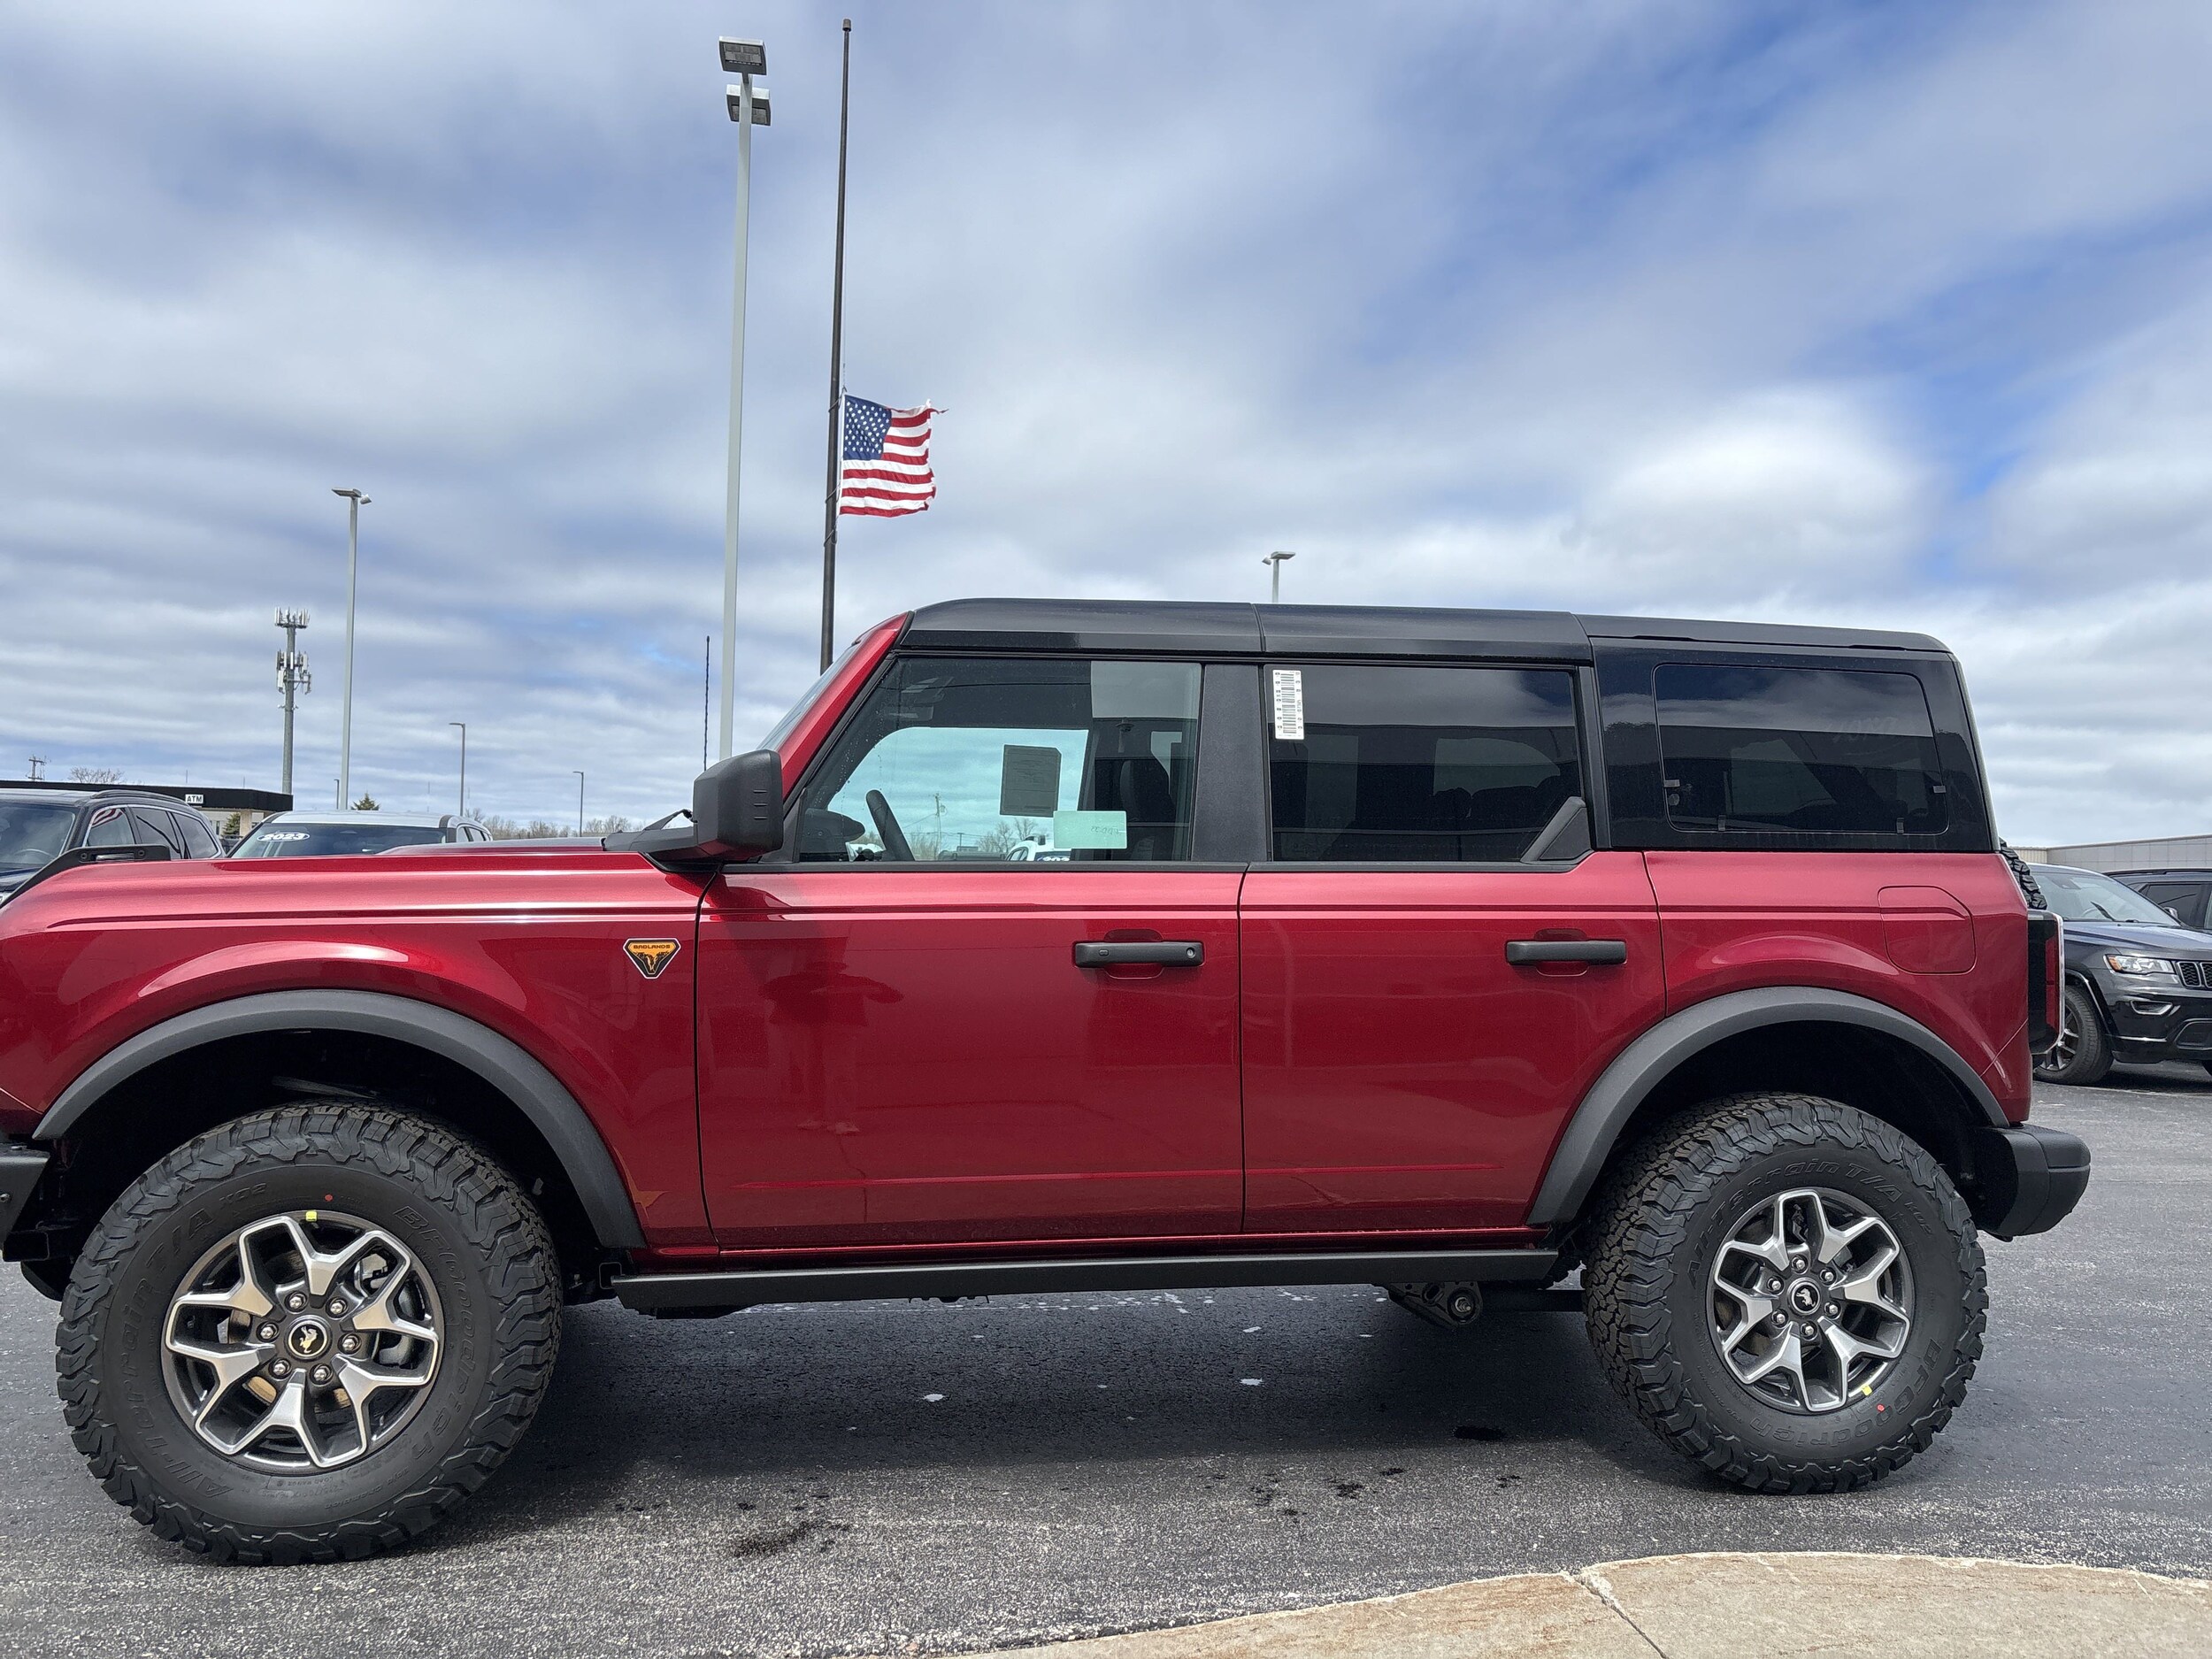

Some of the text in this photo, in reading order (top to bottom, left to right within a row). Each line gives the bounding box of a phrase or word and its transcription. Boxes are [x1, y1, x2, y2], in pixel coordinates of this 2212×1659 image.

[262, 833, 305, 841] 2023
[1845, 1163, 1903, 1203] T/A
[1748, 1338, 1943, 1448] BFGoodrich
